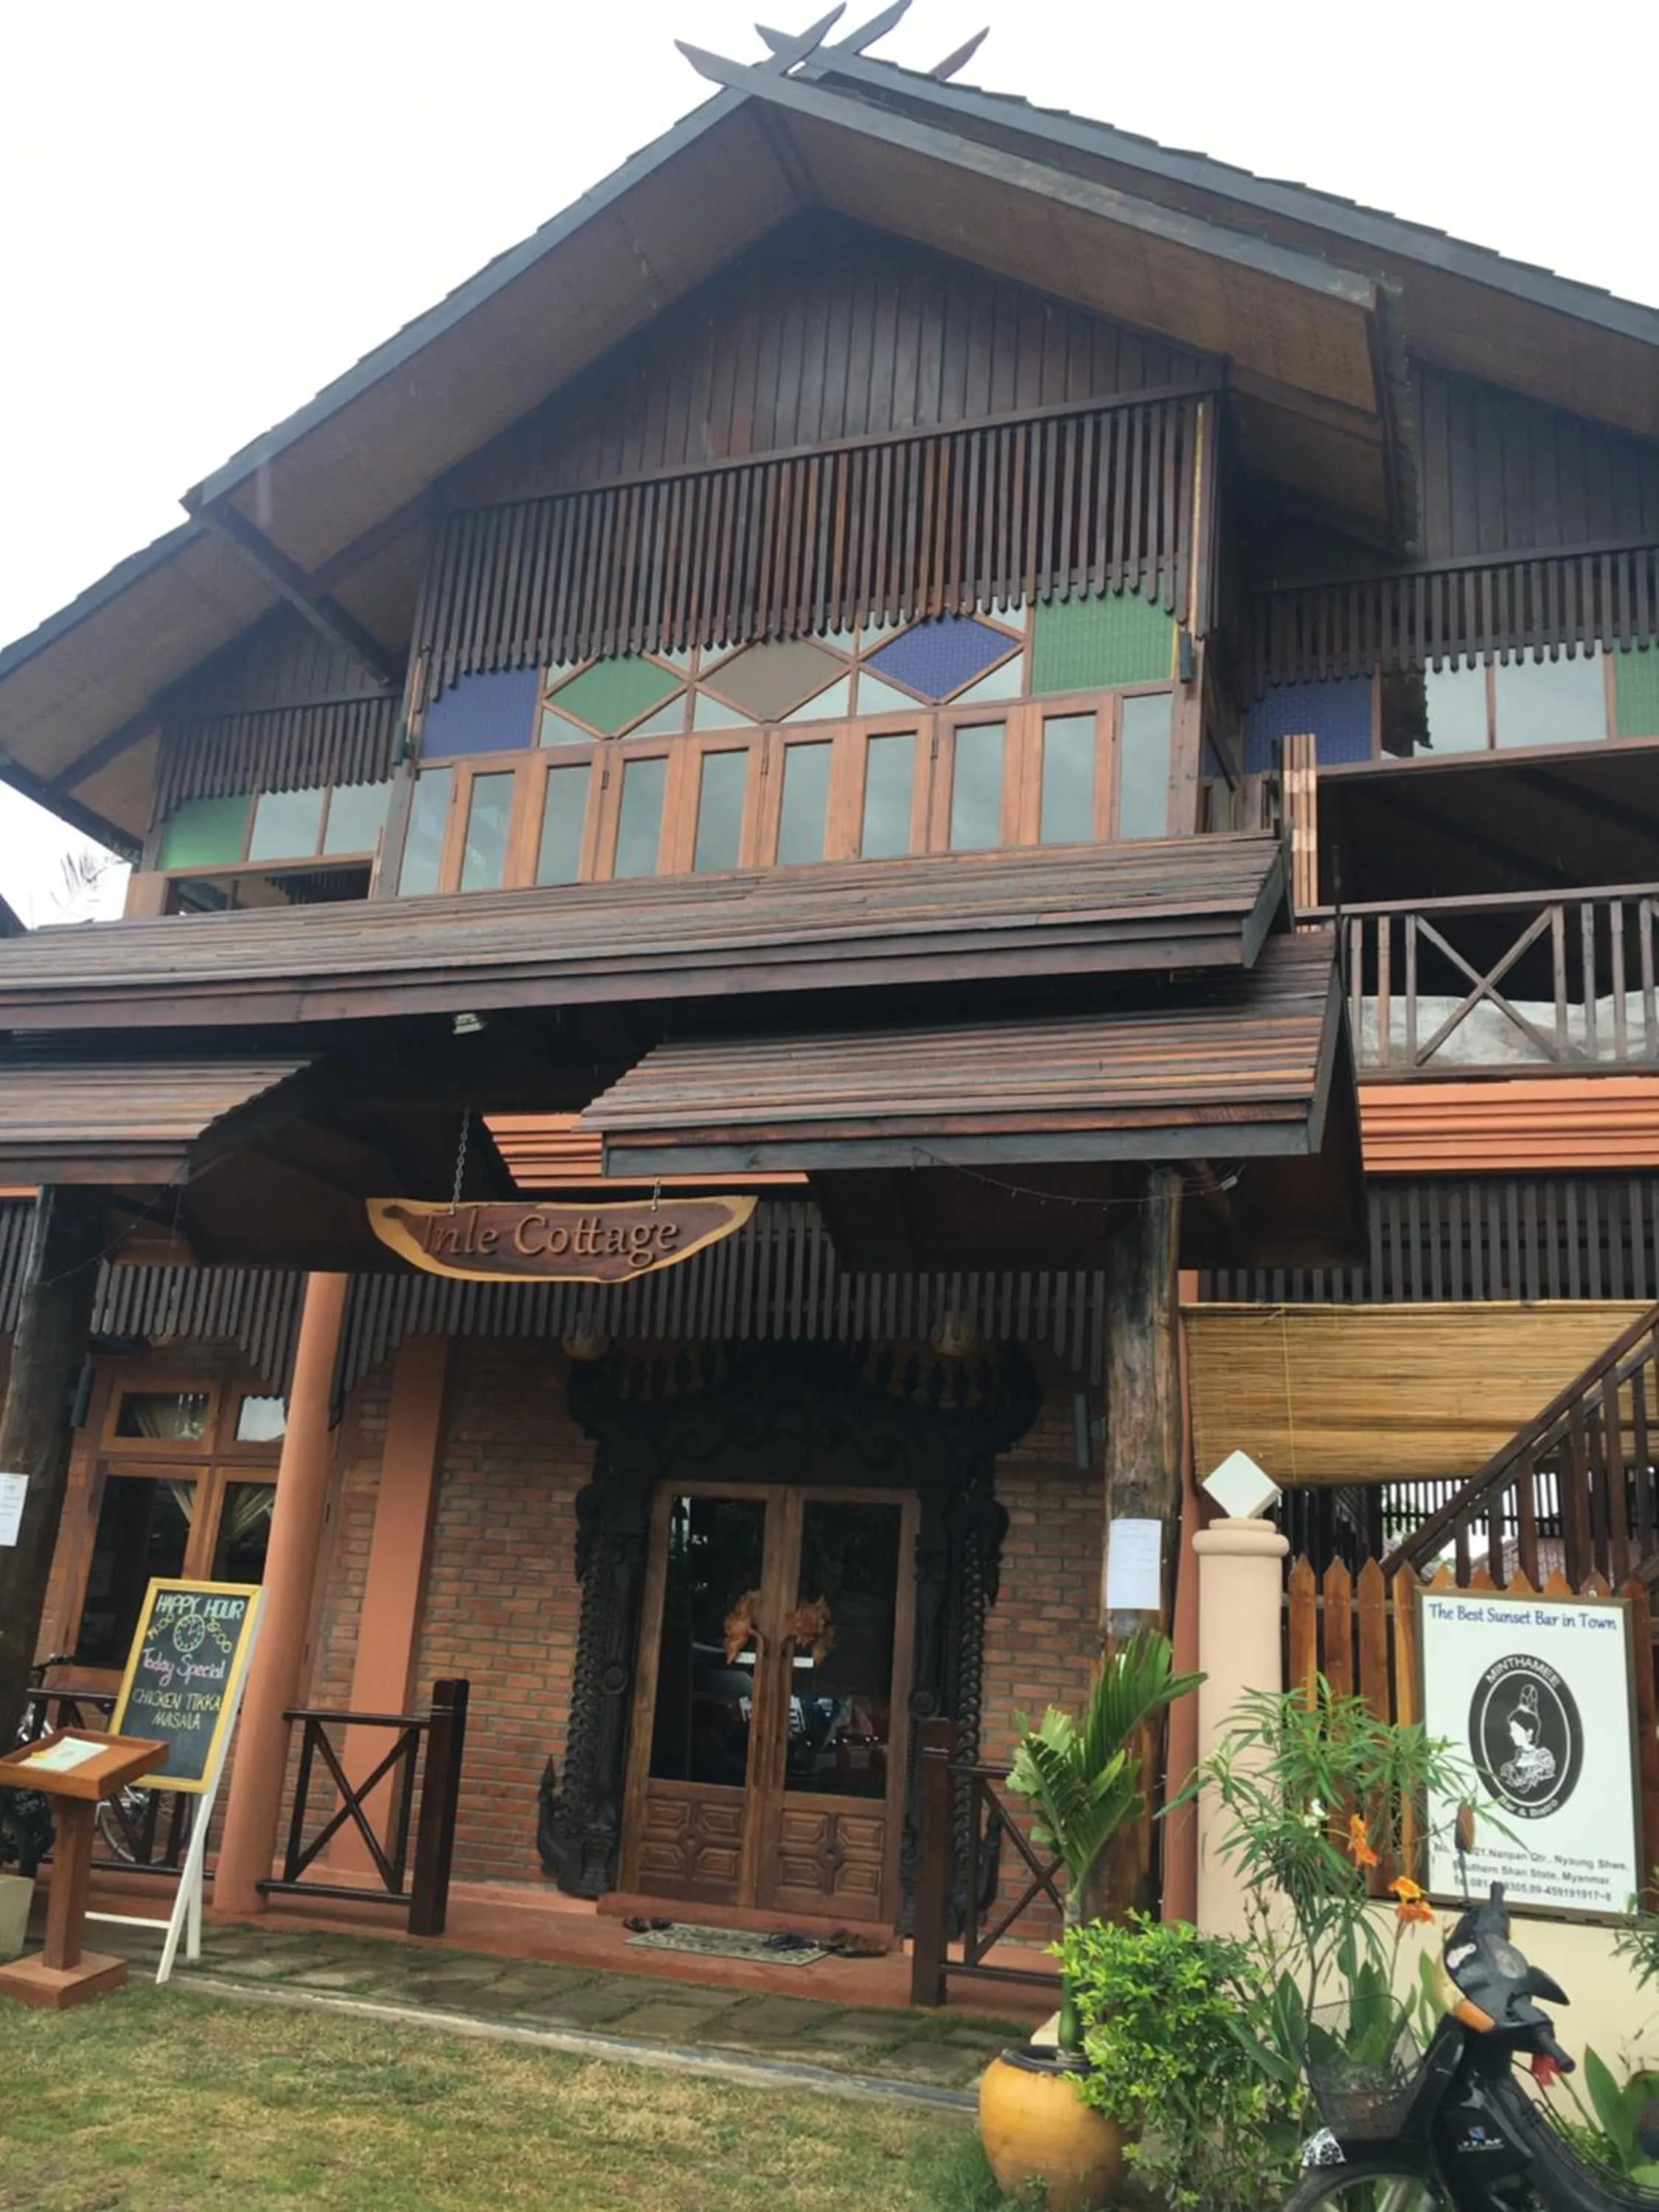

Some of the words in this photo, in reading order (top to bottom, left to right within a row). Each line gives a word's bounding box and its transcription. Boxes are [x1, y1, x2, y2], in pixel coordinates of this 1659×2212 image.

[421, 1207, 498, 1256] Inle
[515, 1212, 679, 1269] Cottage
[156, 1593, 201, 1615] HAPPY
[203, 1599, 246, 1620] HOUR
[1429, 1603, 1453, 1621] The
[1457, 1606, 1484, 1622] Best
[1487, 1607, 1531, 1625] Sunset
[1534, 1610, 1559, 1627] Bar
[1562, 1612, 1576, 1627] in
[1579, 1613, 1617, 1630] Town
[143, 1647, 175, 1687] Today
[176, 1654, 226, 1685] Special
[1486, 1657, 1562, 1688] MINTHAMEE
[132, 1688, 182, 1711] CHICKEN
[185, 1692, 221, 1711] TIKKA
